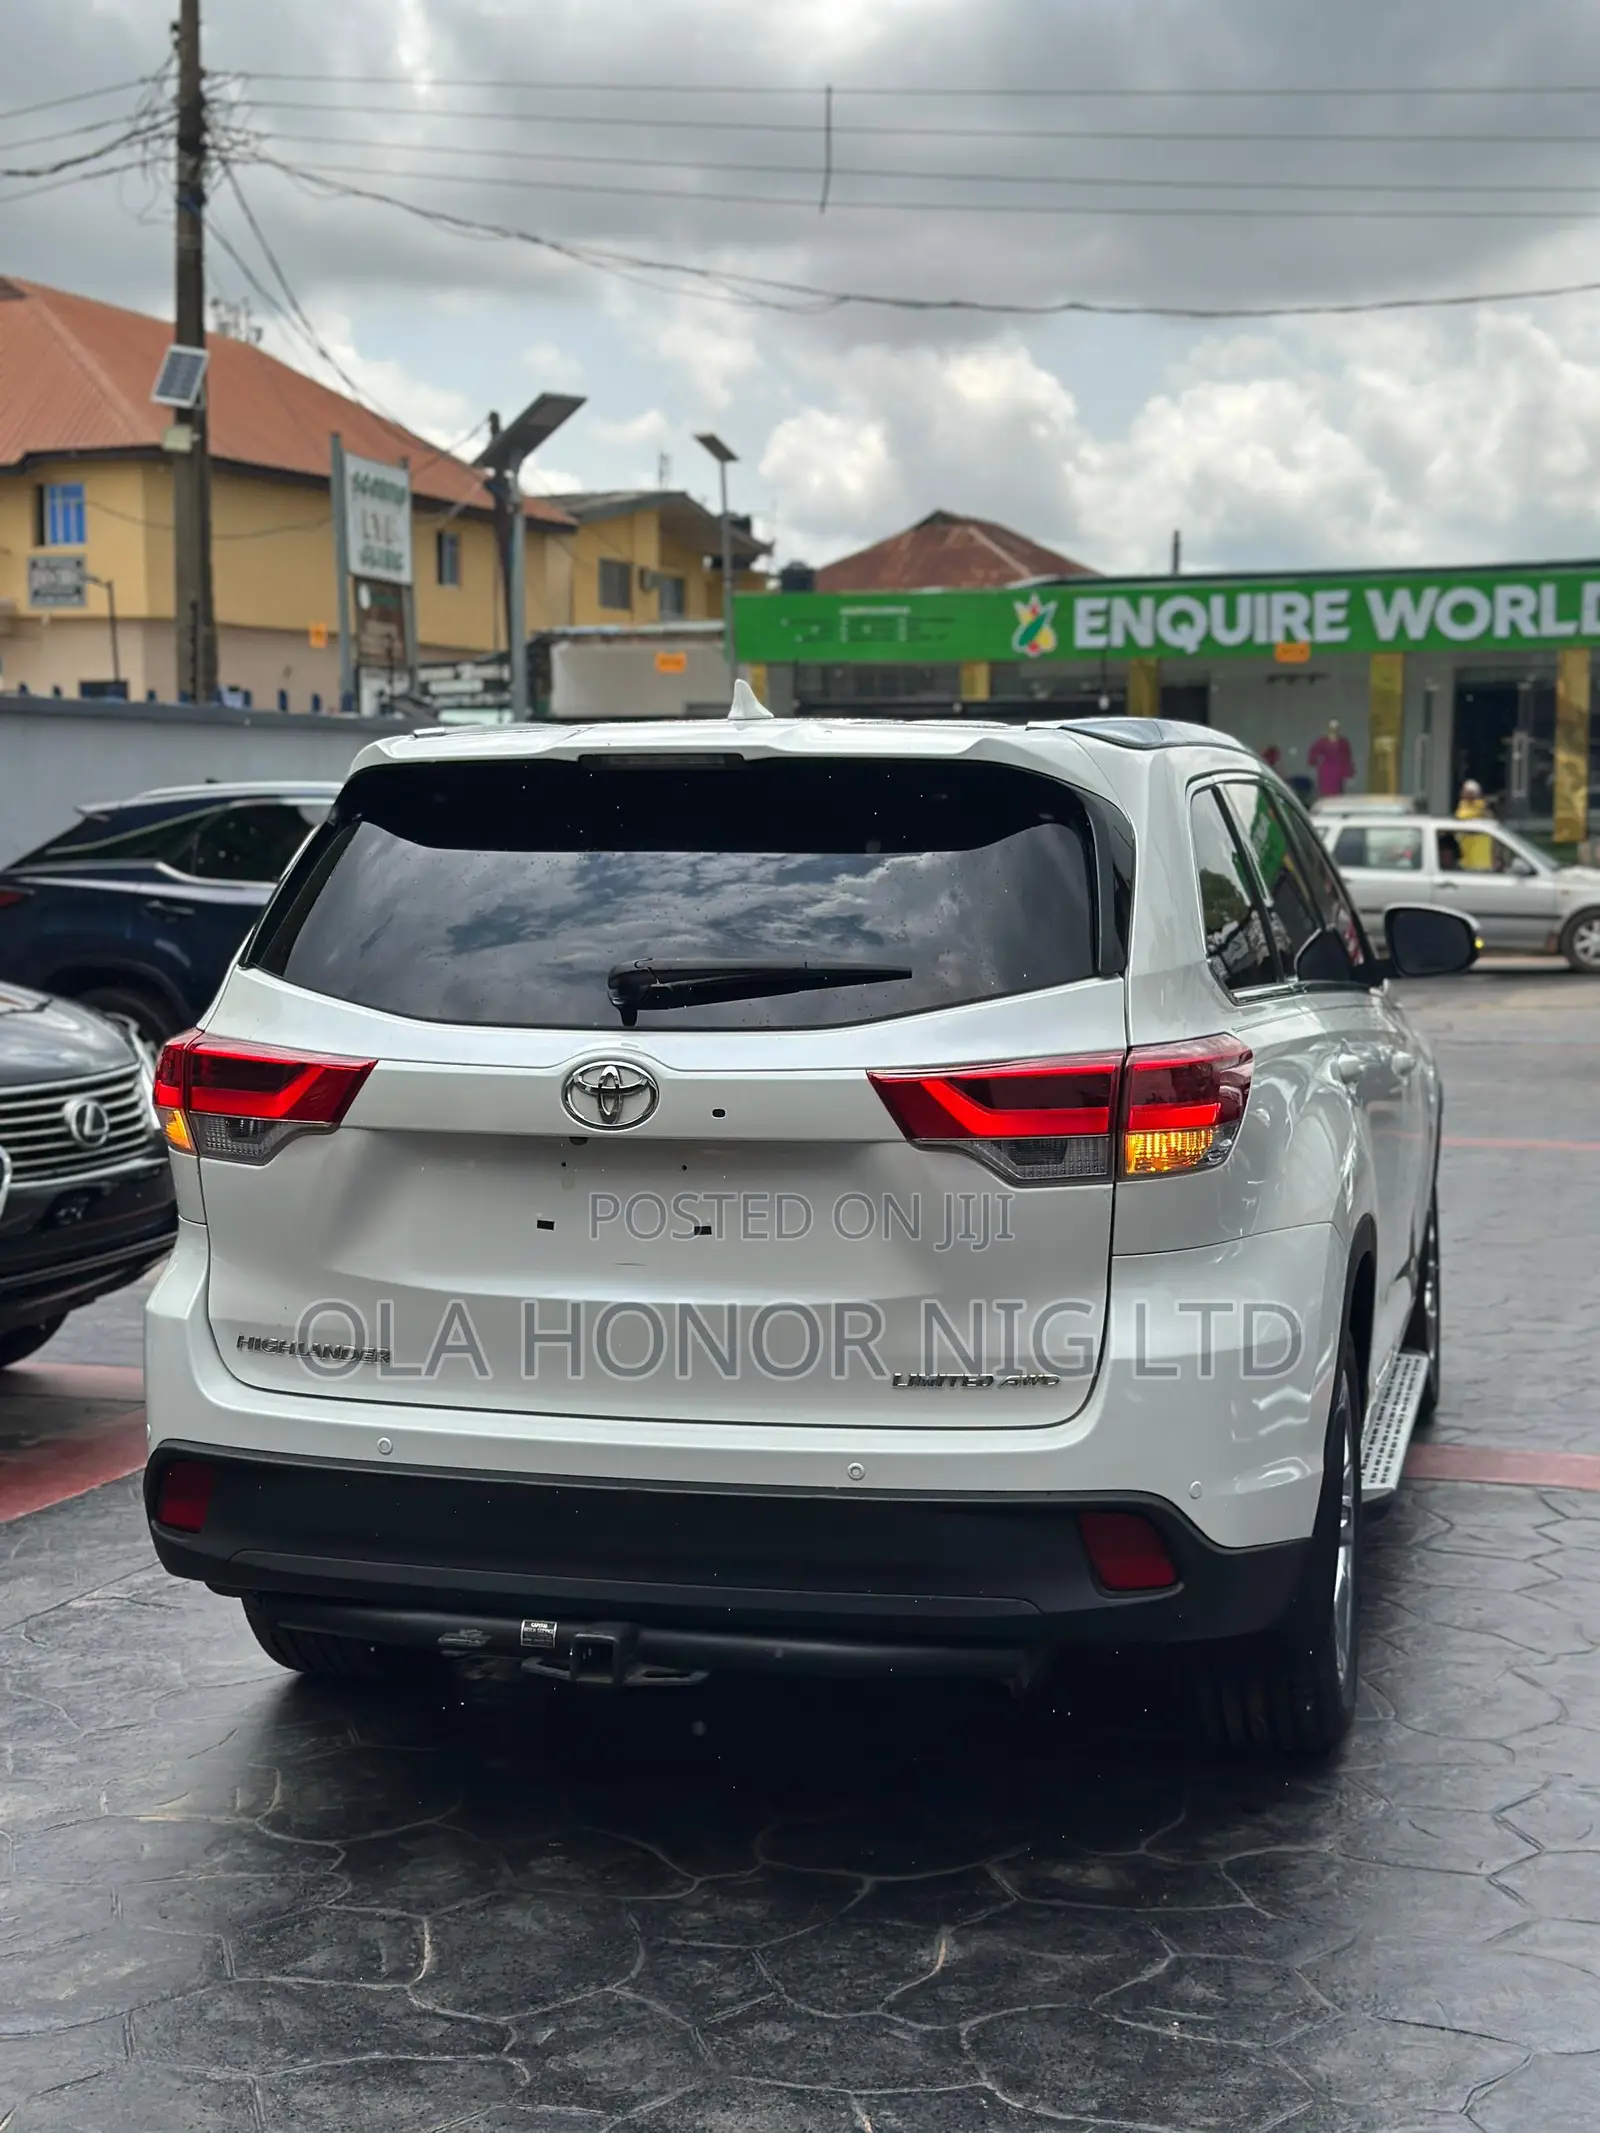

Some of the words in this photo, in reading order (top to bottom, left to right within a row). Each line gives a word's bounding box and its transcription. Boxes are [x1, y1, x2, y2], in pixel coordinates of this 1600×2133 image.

[1073, 589, 1351, 655] ENQUIRE
[236, 1334, 391, 1364] HIGHLANDER
[892, 1372, 996, 1388] LIMITED
